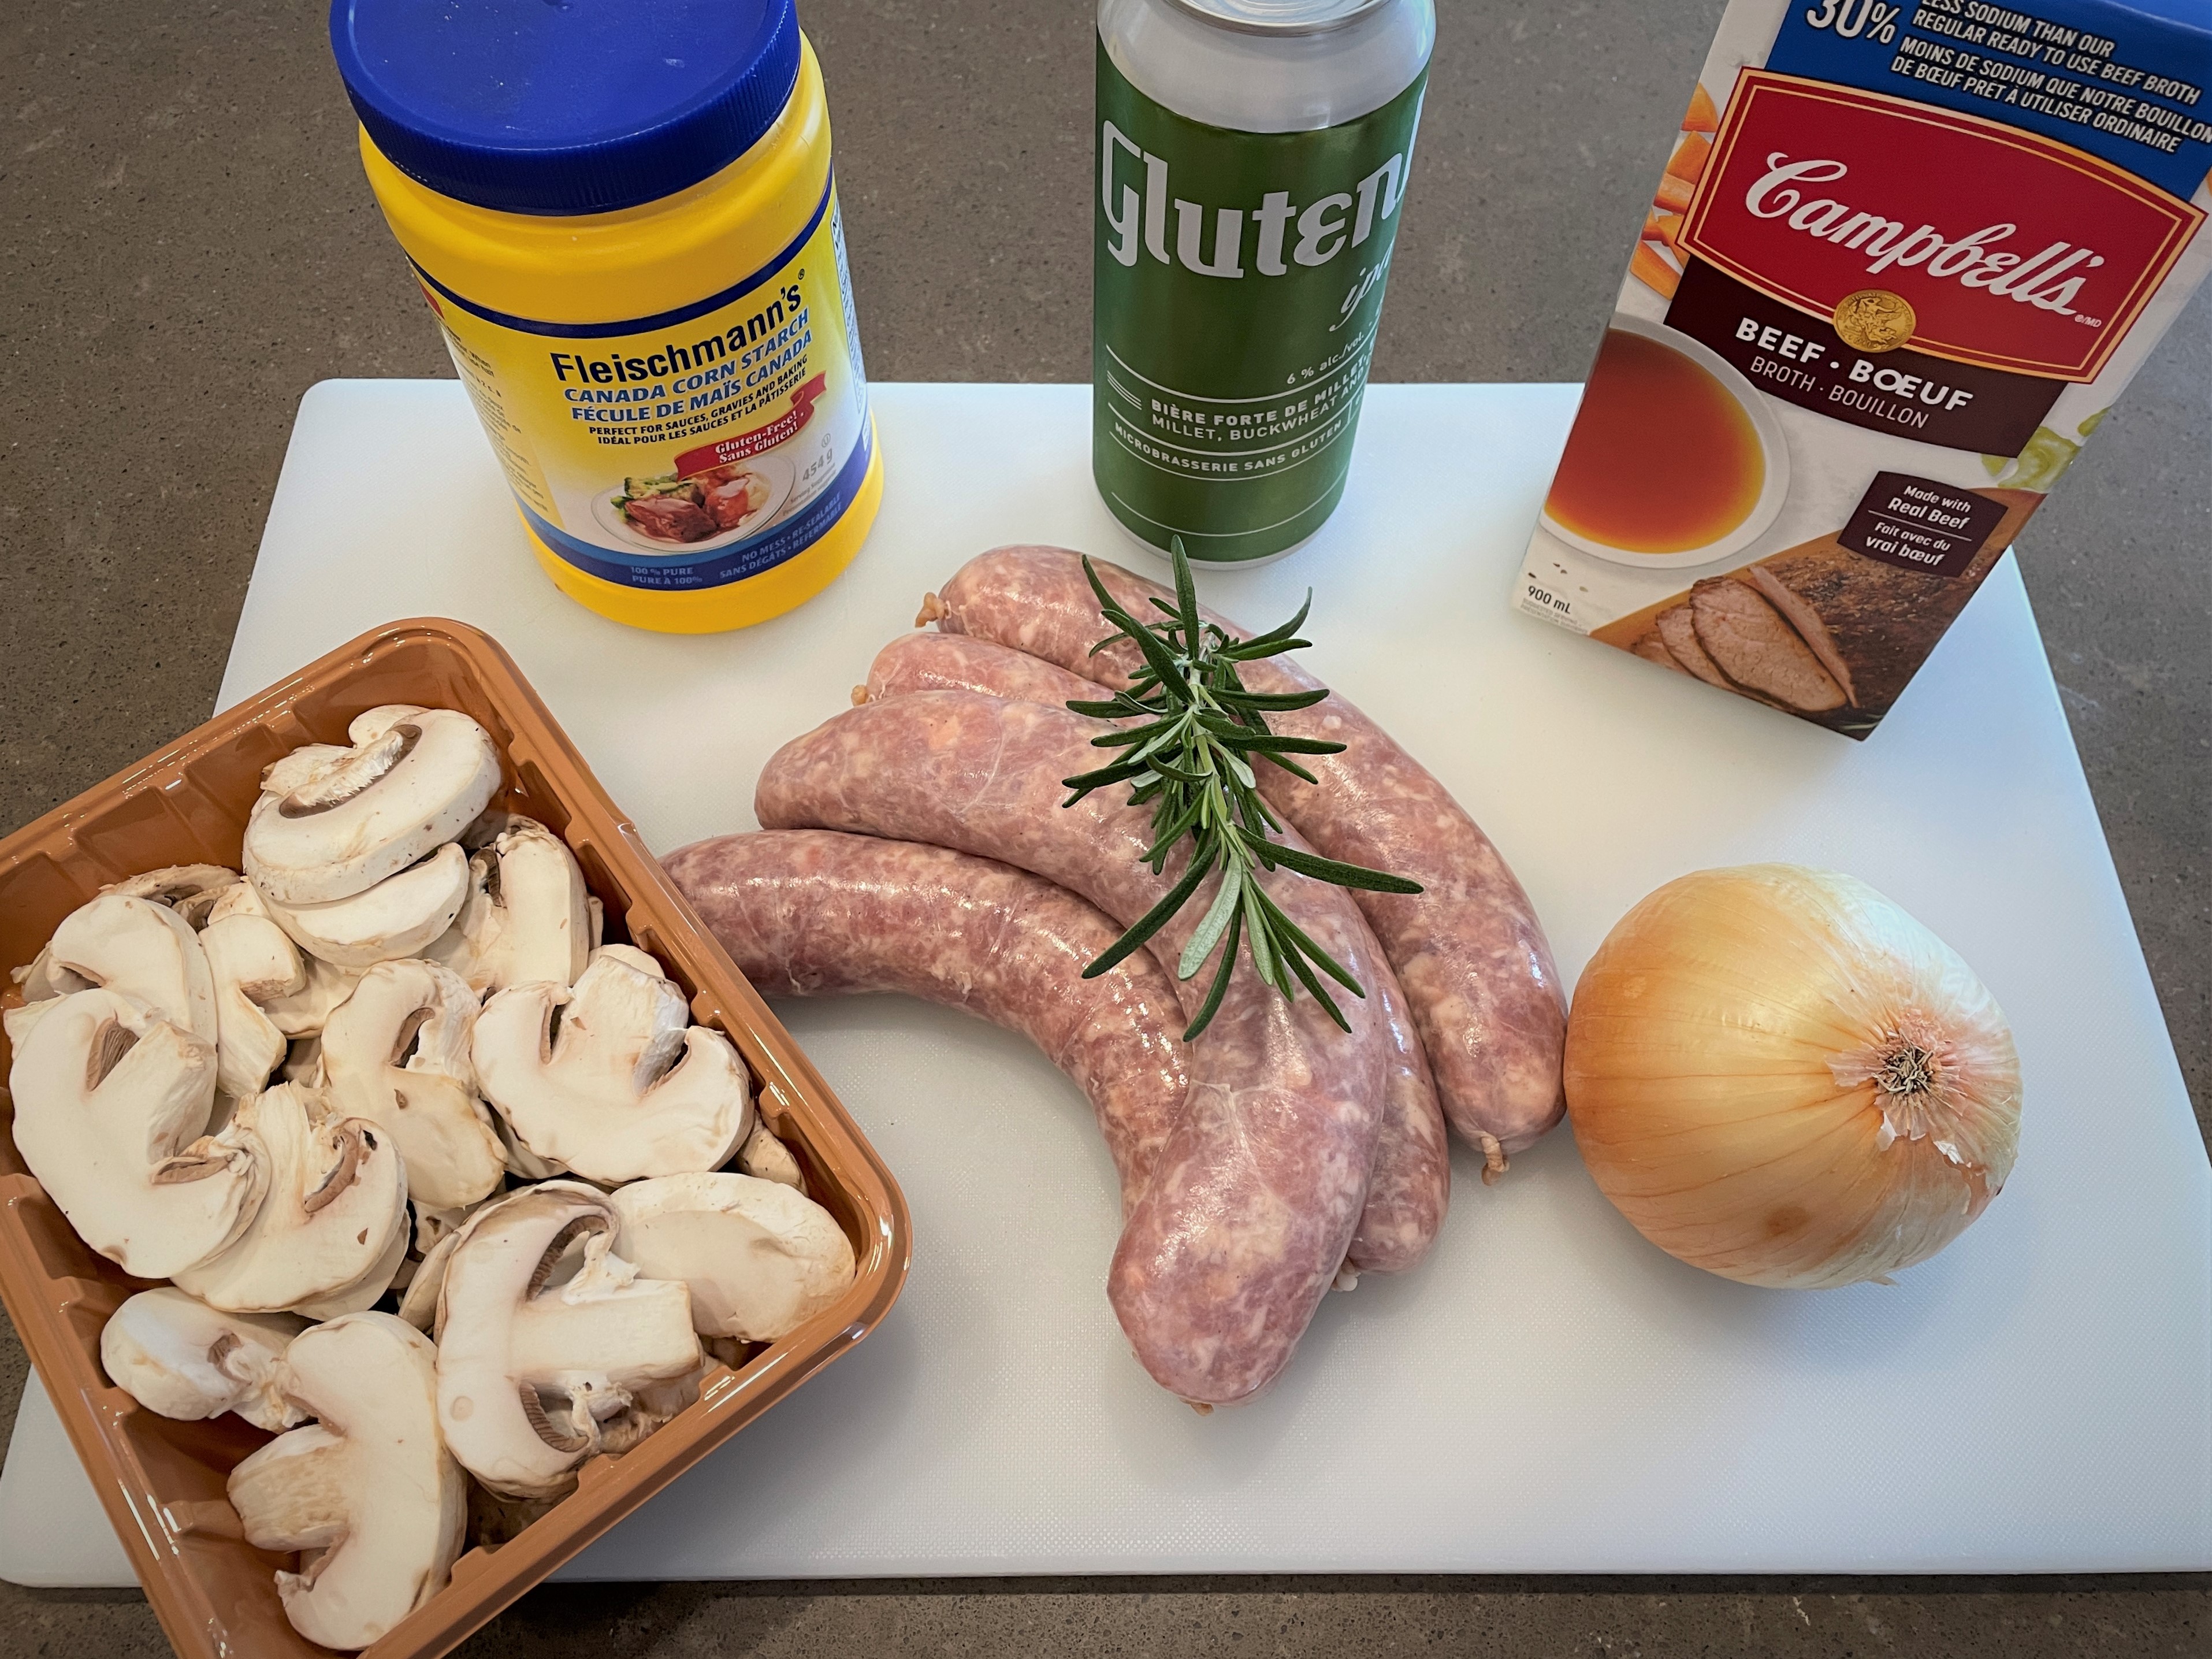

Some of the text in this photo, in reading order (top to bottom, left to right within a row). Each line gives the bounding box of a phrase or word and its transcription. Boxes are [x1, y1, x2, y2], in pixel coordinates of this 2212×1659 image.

[1807, 0, 1900, 43] 30%
[1965, 1, 2032, 34] SODIUM
[2032, 21, 2080, 47] THAN
[2079, 35, 2115, 57] OUR
[1913, 9, 2201, 105] REGULAR READY TO USE BEEF BROTH
[1891, 55, 1915, 74] DE
[1916, 64, 1961, 87] BŒUF
[2005, 86, 2019, 103] À
[2021, 92, 2092, 123] UTILISER
[2092, 112, 2182, 153] ORDINAIRE
[1900, 37, 2212, 143] MOINS DE SODIUM QUE NOTRE BOUILLON
[1102, 120, 1415, 279] Gluten
[1745, 152, 2105, 316] Campbell's
[550, 284, 802, 384] Fleischmann's
[565, 308, 809, 403] CANADA CORN STARCH
[572, 331, 812, 422] FÉCULE DE MAÏS CANADA
[1287, 373, 1296, 384] 6
[1301, 368, 1314, 379] %
[1735, 317, 1826, 363] BEEF
[1849, 359, 1973, 411] BŒUF
[589, 356, 808, 435] PERFECT FOR SAUCES, GRAVIES AND BAKING
[598, 367, 806, 444] IDÉAL POUR LES SAUCES ET LA PÂTISSERIE
[1151, 399, 1205, 425] BIÈRE
[1214, 411, 1277, 426] FORTE
[1285, 399, 1307, 417] DE
[1750, 356, 1930, 428] BROTH BOUILLON
[716, 410, 797, 454] Gluten-Free!
[720, 421, 798, 462] Sans Gluten!
[1153, 414, 1222, 441] MILLET,
[1230, 398, 1337, 440] BUCKWHEAT
[802, 448, 832, 481] 454 g
[1116, 420, 1341, 472] MICROBRASSERIE SANS GLUTEN
[1888, 498, 1970, 529] Real Beef
[1904, 485, 1971, 513] Made with
[742, 551, 757, 562] NO
[760, 537, 786, 555] MESS
[1866, 536, 1945, 565] vrai bœuf
[1875, 522, 1951, 551] Fait avec du
[632, 575, 662, 584] PURE
[674, 576, 702, 584] 100%
[720, 565, 746, 578] SANS
[1528, 585, 1552, 604] 900
[1553, 599, 1571, 614] mL
